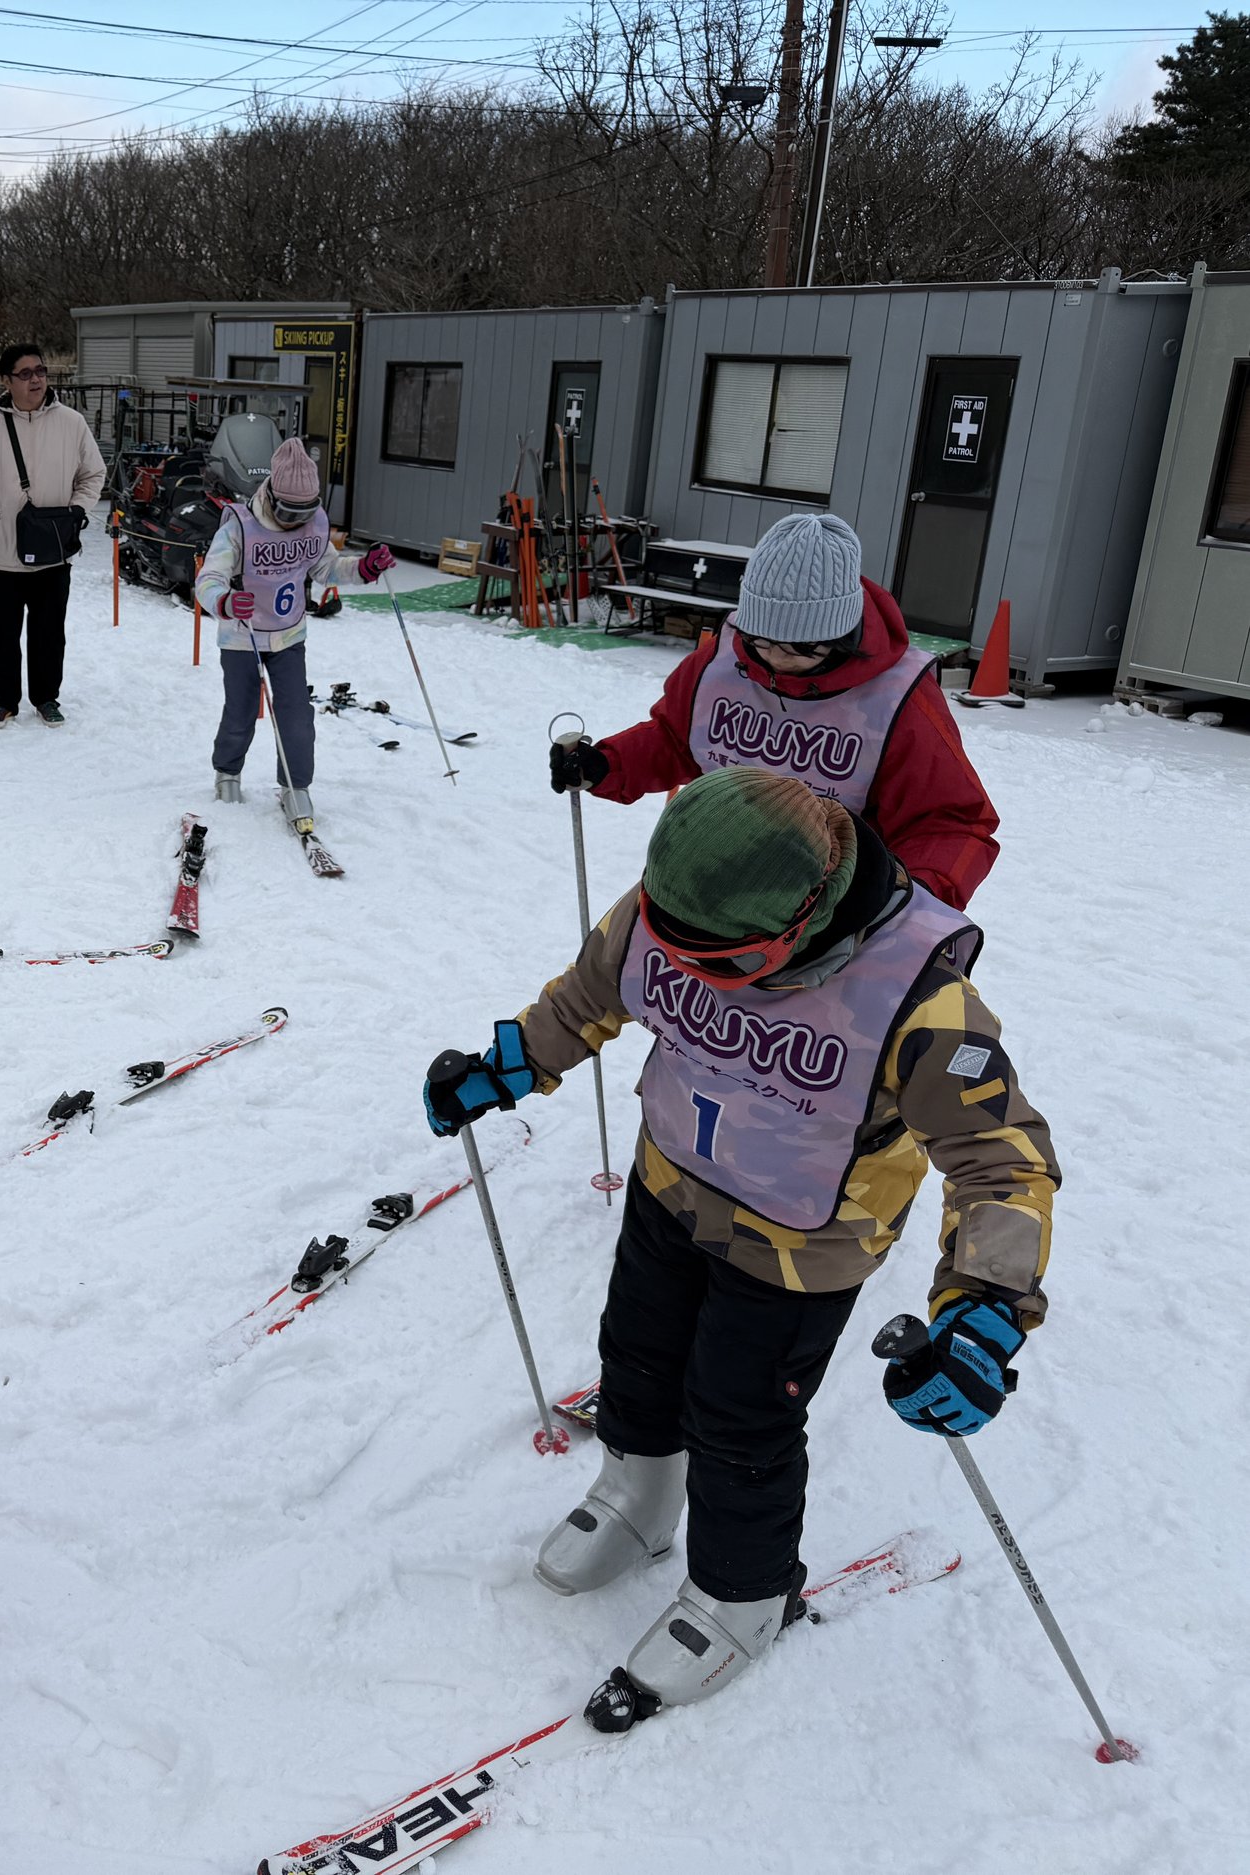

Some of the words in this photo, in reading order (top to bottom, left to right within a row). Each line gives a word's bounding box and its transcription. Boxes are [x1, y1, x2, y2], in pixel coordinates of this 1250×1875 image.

[283, 331, 307, 345] SKIING
[308, 331, 334, 345] PICKUP
[953, 399, 972, 410] FIRST
[973, 400, 984, 410] AID
[948, 446, 974, 456] PATROL
[252, 535, 322, 567] KUJYU
[272, 580, 296, 618] 6
[708, 697, 863, 781] KUJYU
[644, 947, 848, 1092] KUJYU
[690, 1087, 726, 1165] 1
